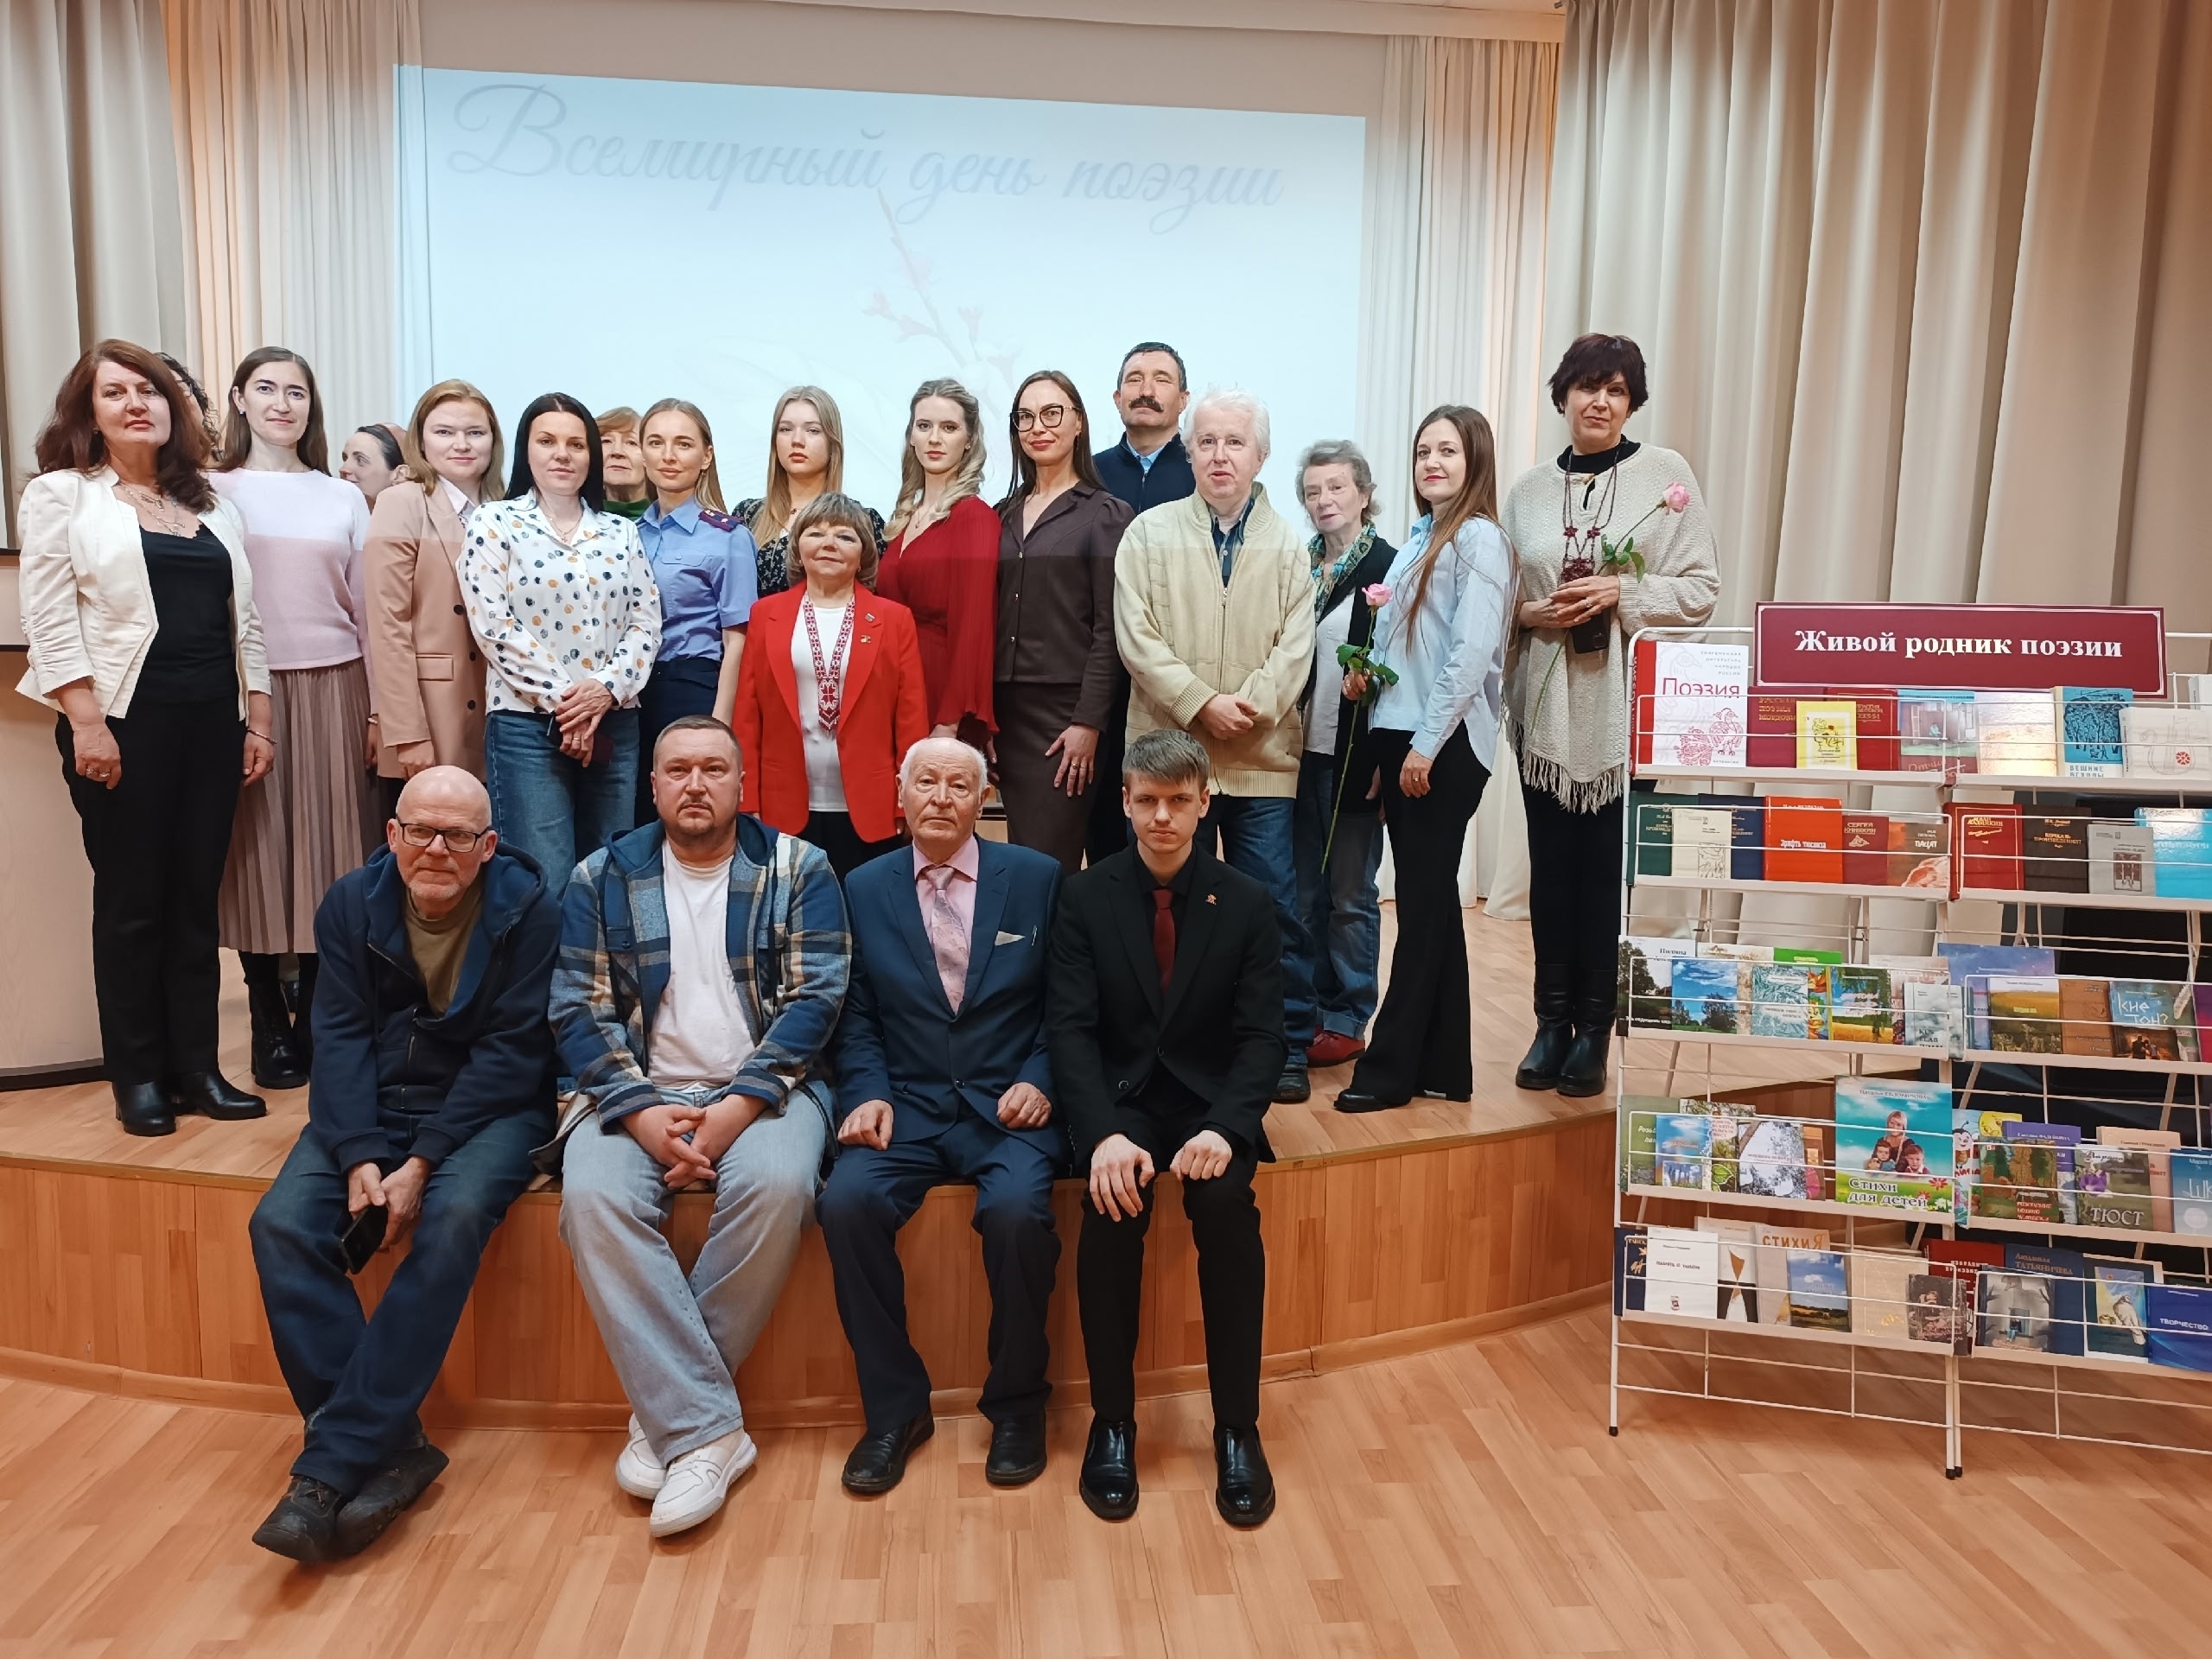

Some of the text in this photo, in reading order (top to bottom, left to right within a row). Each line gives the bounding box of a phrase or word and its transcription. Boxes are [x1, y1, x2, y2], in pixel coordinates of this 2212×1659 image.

[446, 82, 1286, 234] Всемирный день поэзии
[1795, 630, 2123, 658] Живой родник поэзии
[1662, 677, 1740, 698] Поэзия
[1848, 1177, 1898, 1192] Стихи
[1847, 1192, 1929, 1208] для детей
[2089, 1207, 2145, 1226] ТЮСТ
[1762, 1234, 1825, 1249] СТИХИЯ
[2015, 1252, 2050, 1262] Людмила
[2015, 1262, 2074, 1275] ТАТЬЯНИЧЕВА
[2159, 1318, 2209, 1331] ТВОРЧЕСТВО
